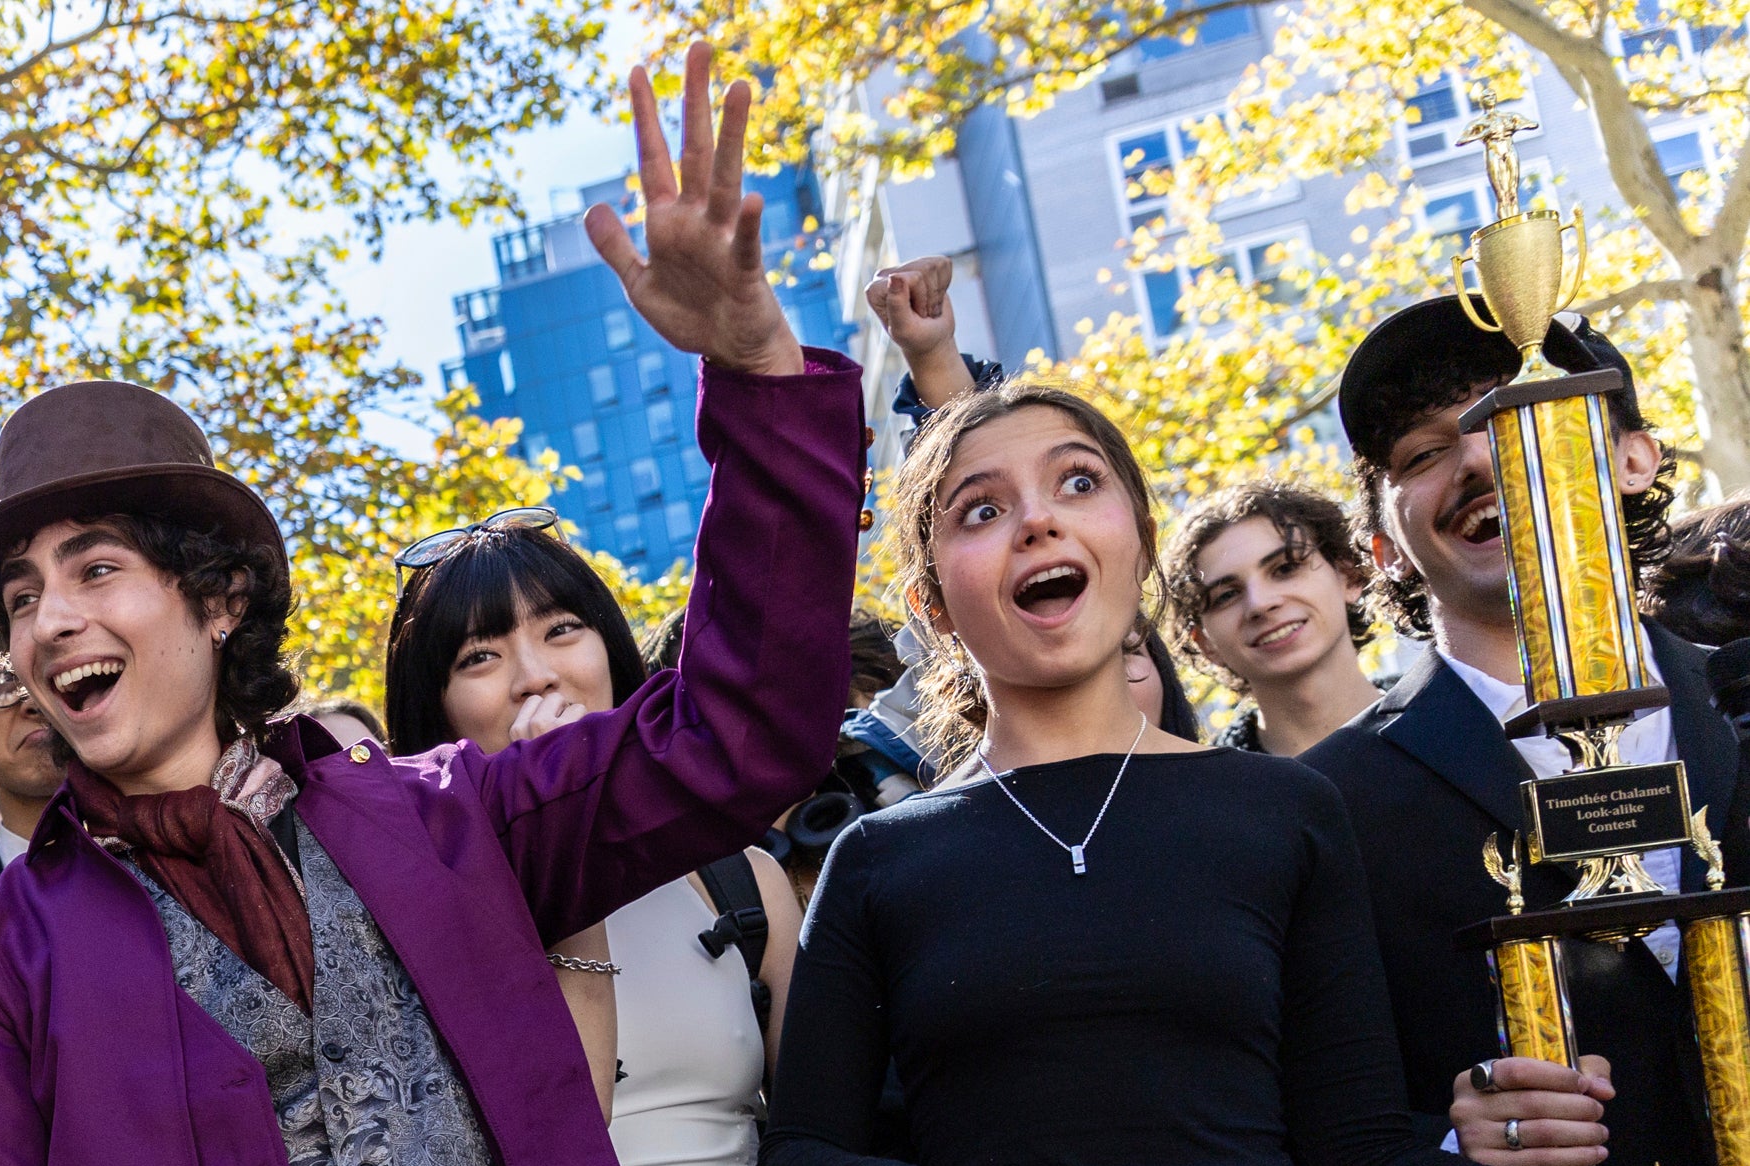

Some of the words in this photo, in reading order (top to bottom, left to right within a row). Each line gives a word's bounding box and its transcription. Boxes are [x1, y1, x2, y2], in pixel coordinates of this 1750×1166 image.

[1546, 792, 1608, 810] Timothée
[1610, 784, 1672, 801] Chalamet
[1577, 803, 1645, 820] Look-alike
[1588, 819, 1638, 834] Contest
